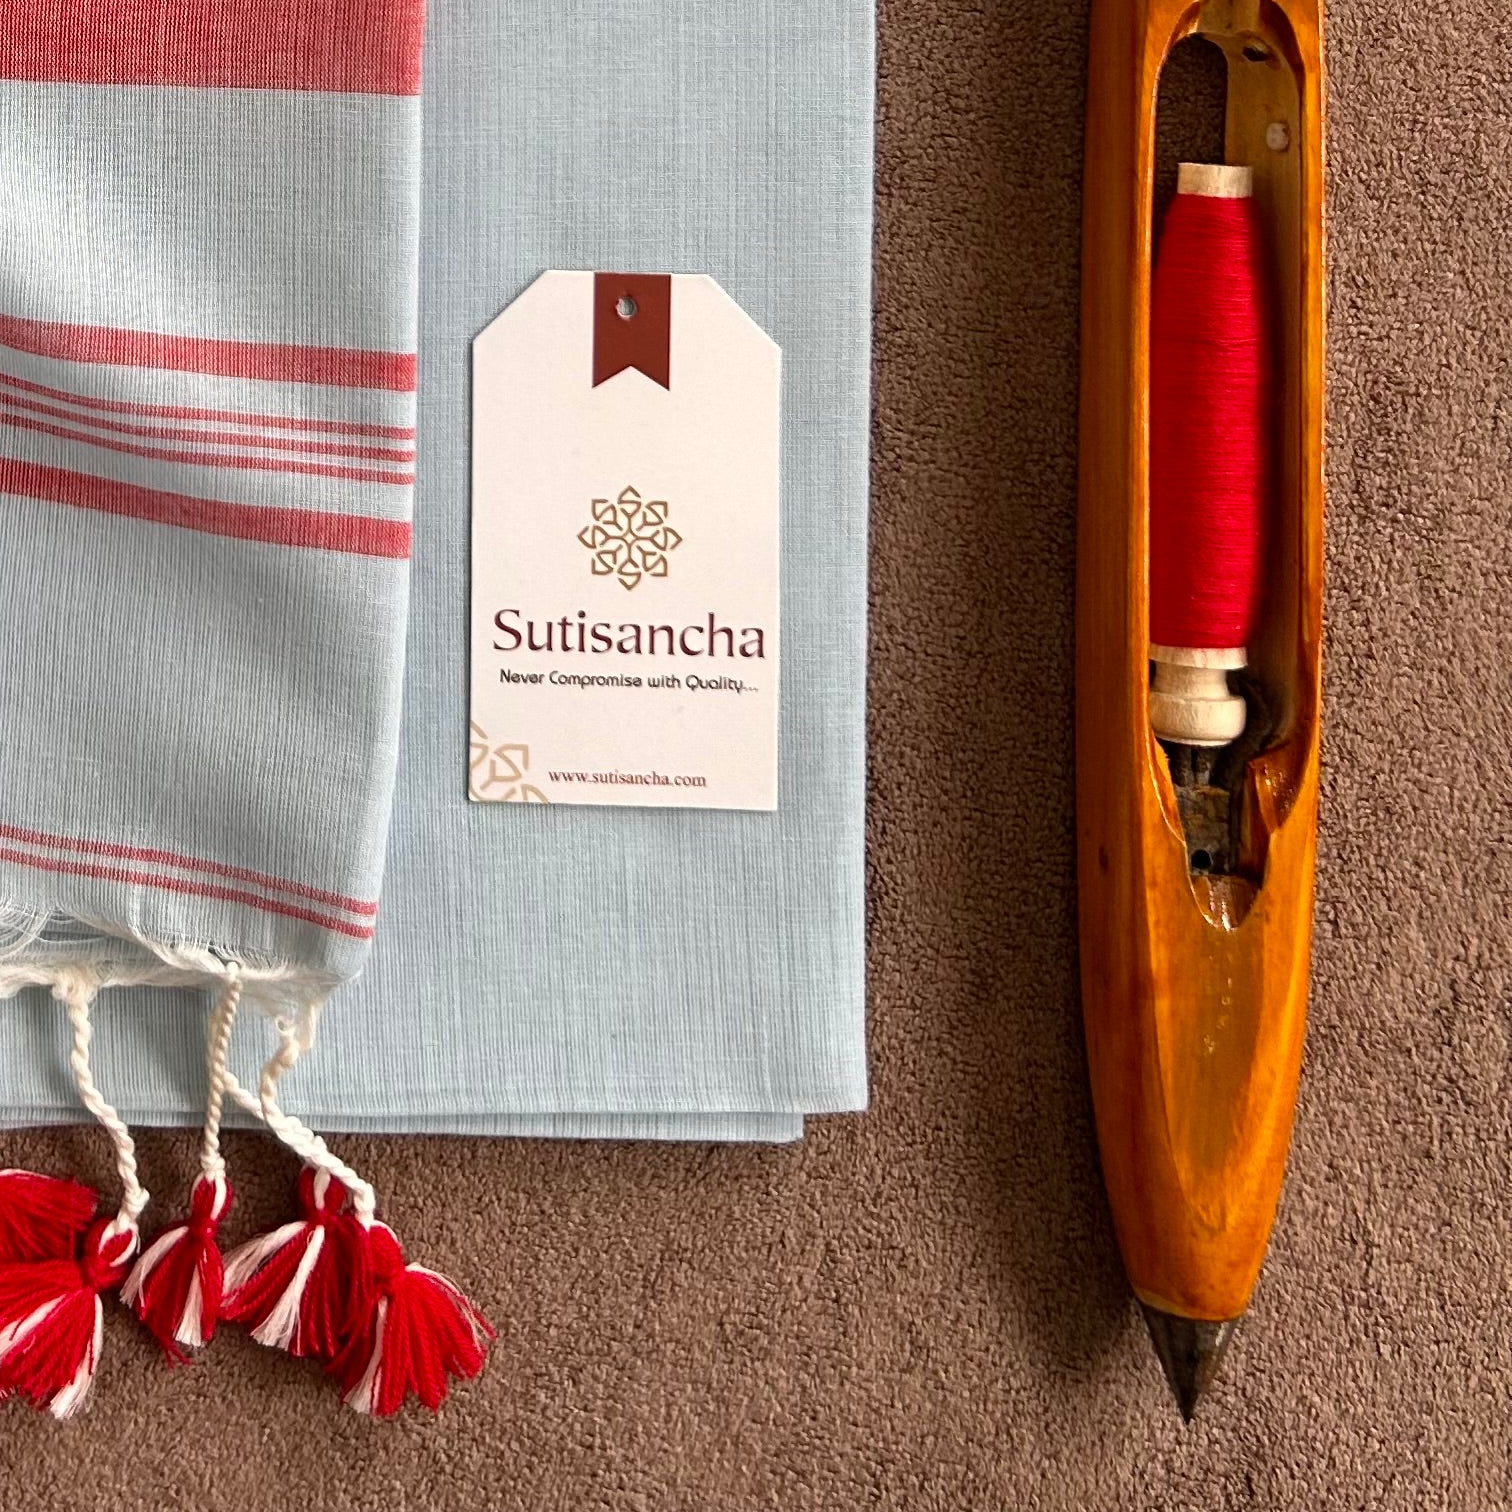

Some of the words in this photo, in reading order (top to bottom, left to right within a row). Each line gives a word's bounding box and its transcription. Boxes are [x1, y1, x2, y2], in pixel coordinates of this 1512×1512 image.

[492, 608, 766, 659] Sutisancha
[499, 667, 545, 686] Never
[549, 669, 643, 691] Compromise
[647, 670, 681, 690] with
[548, 770, 707, 787] www.sutisancha.com
